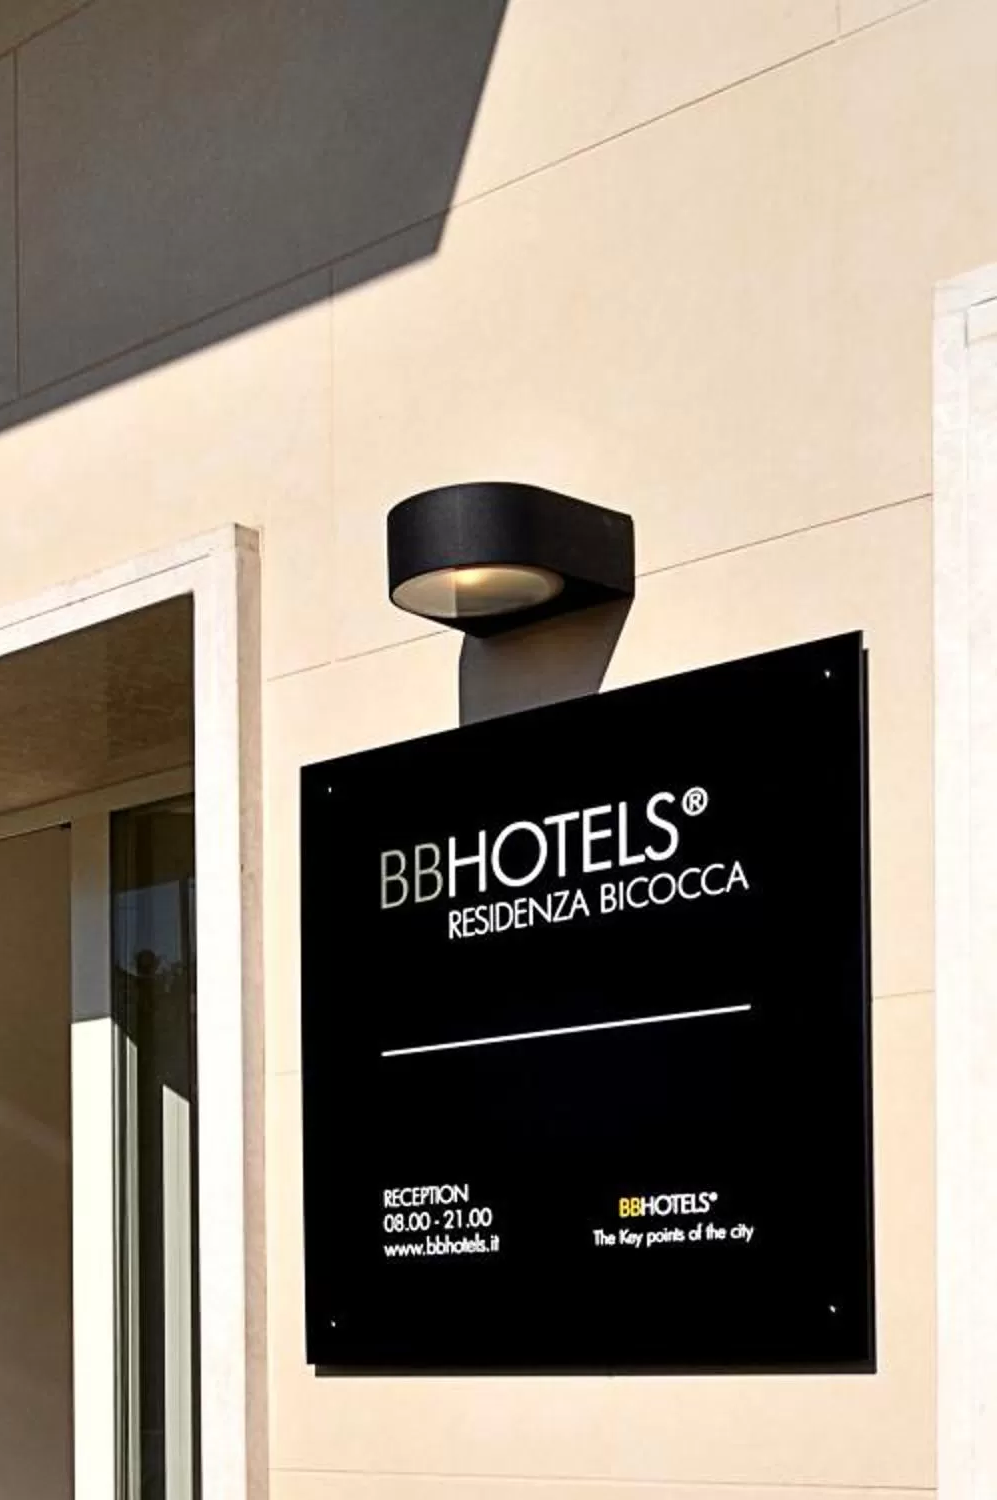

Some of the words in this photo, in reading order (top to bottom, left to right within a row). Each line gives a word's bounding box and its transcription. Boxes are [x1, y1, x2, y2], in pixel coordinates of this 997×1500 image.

[448, 888, 591, 940] RESIDENZA
[599, 859, 751, 914] BICOCCA
[383, 1183, 469, 1208] RECEPTION
[383, 1211, 431, 1233] 08.00
[443, 1206, 493, 1230] 21.00
[383, 1232, 500, 1257] www.bbhotels.it
[592, 1228, 616, 1246] The
[618, 1228, 644, 1249] Key
[646, 1227, 686, 1248] points
[688, 1222, 703, 1242] of
[705, 1222, 727, 1241] the
[729, 1223, 754, 1243] city
